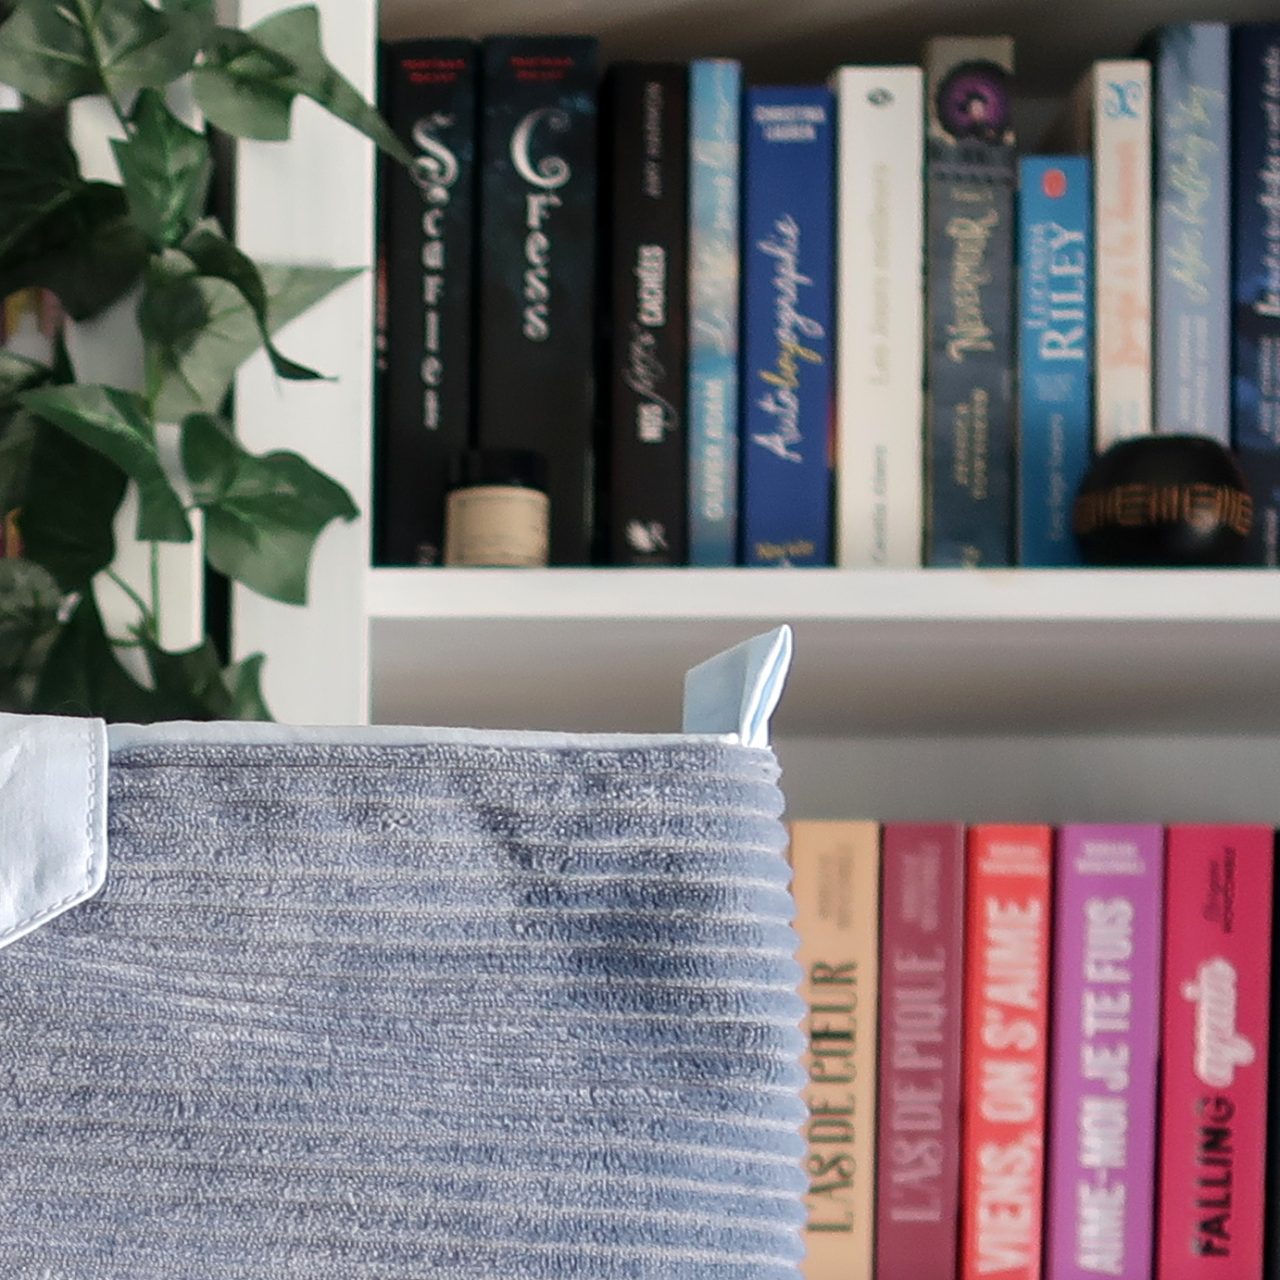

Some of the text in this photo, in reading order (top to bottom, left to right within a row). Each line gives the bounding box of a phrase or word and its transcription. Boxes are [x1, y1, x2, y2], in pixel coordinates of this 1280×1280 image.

[1037, 221, 1086, 363] RILEY
[1082, 898, 1136, 983] FUIS
[892, 945, 947, 1069] PIQUE
[1080, 992, 1132, 1035] TE
[979, 1063, 1037, 1124] ON
[1078, 1044, 1130, 1091] JE
[807, 1091, 857, 1144] DE
[892, 1080, 945, 1130] DE
[1076, 1098, 1128, 1276] AIME-MOI
[1191, 1097, 1235, 1258] FALLING
